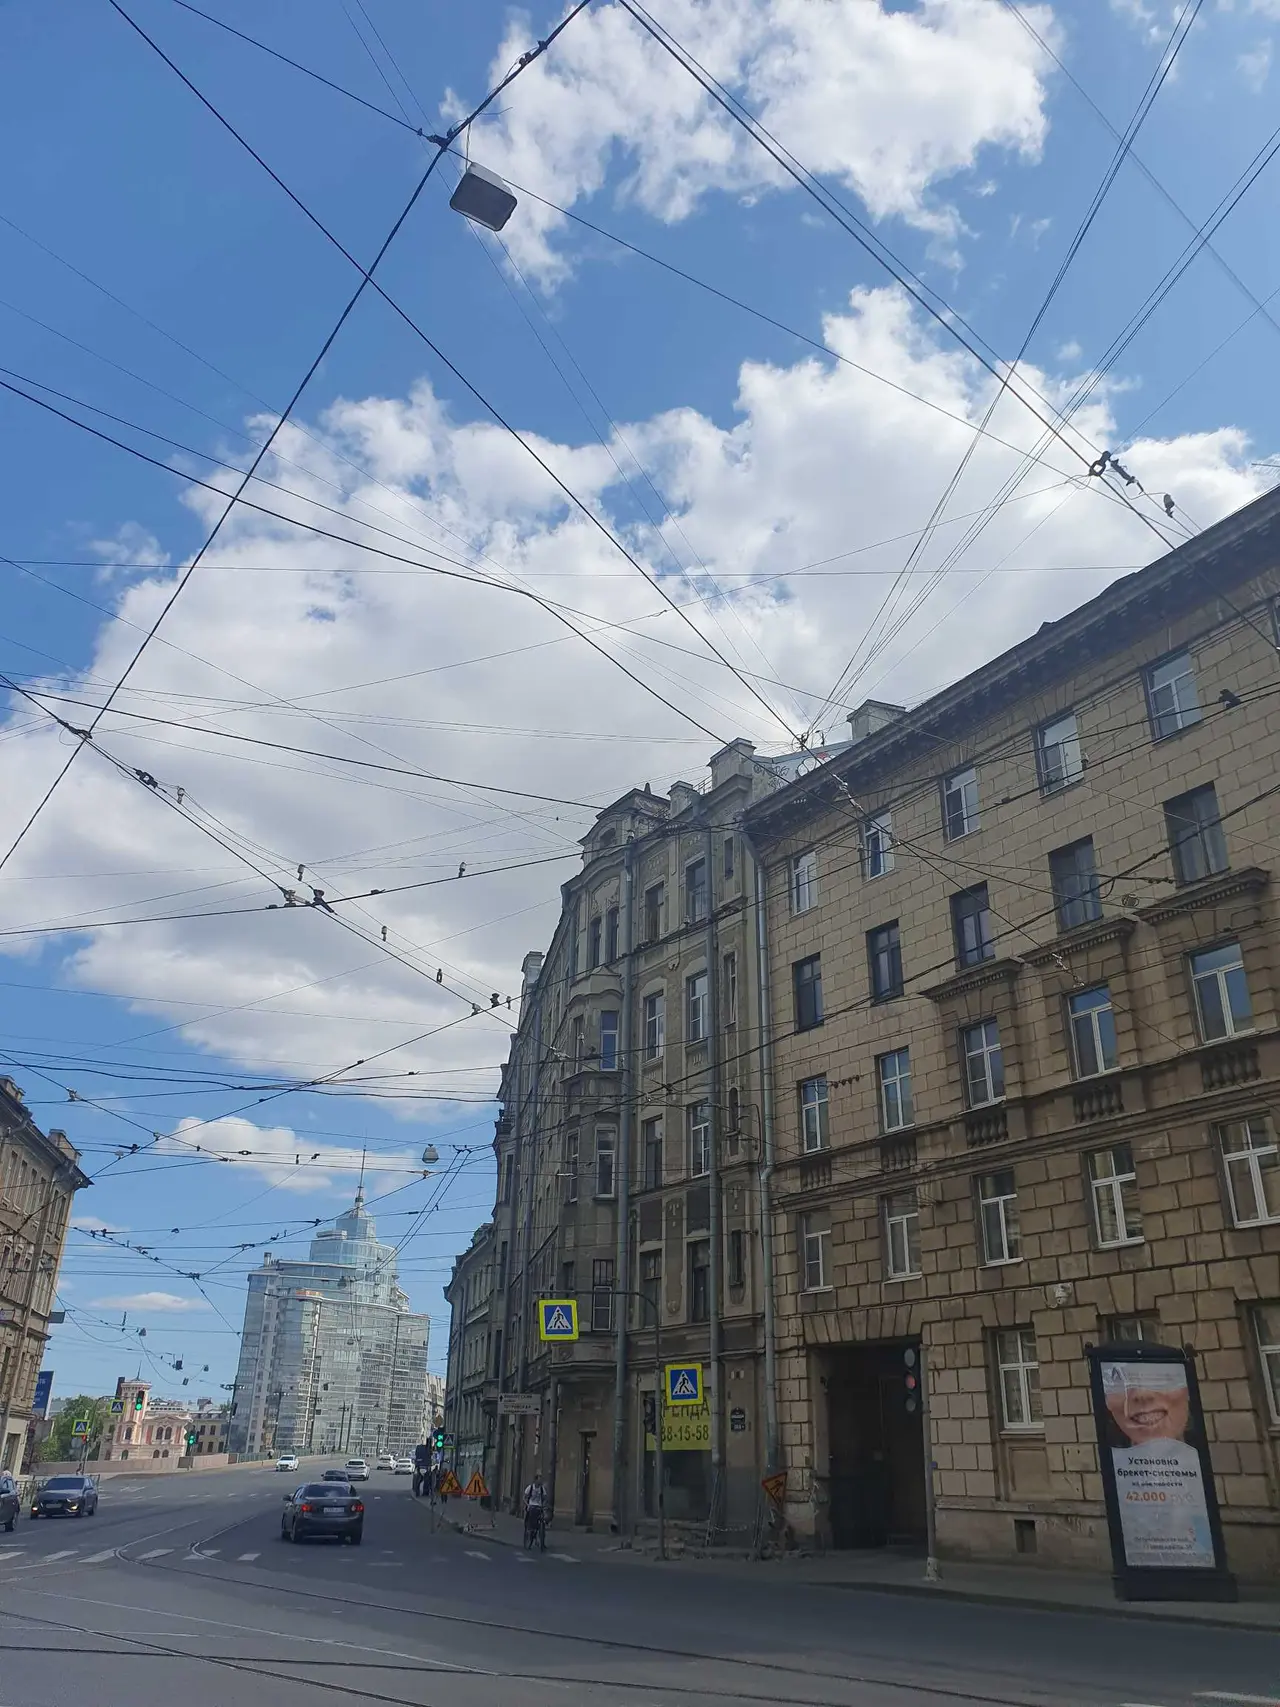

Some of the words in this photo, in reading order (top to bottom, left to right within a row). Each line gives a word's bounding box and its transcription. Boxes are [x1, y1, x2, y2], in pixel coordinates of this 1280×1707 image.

[1128, 1457, 1179, 1466] Установка
[1117, 1468, 1197, 1478] брекет-системы
[1126, 1491, 1166, 1502] 42.000
